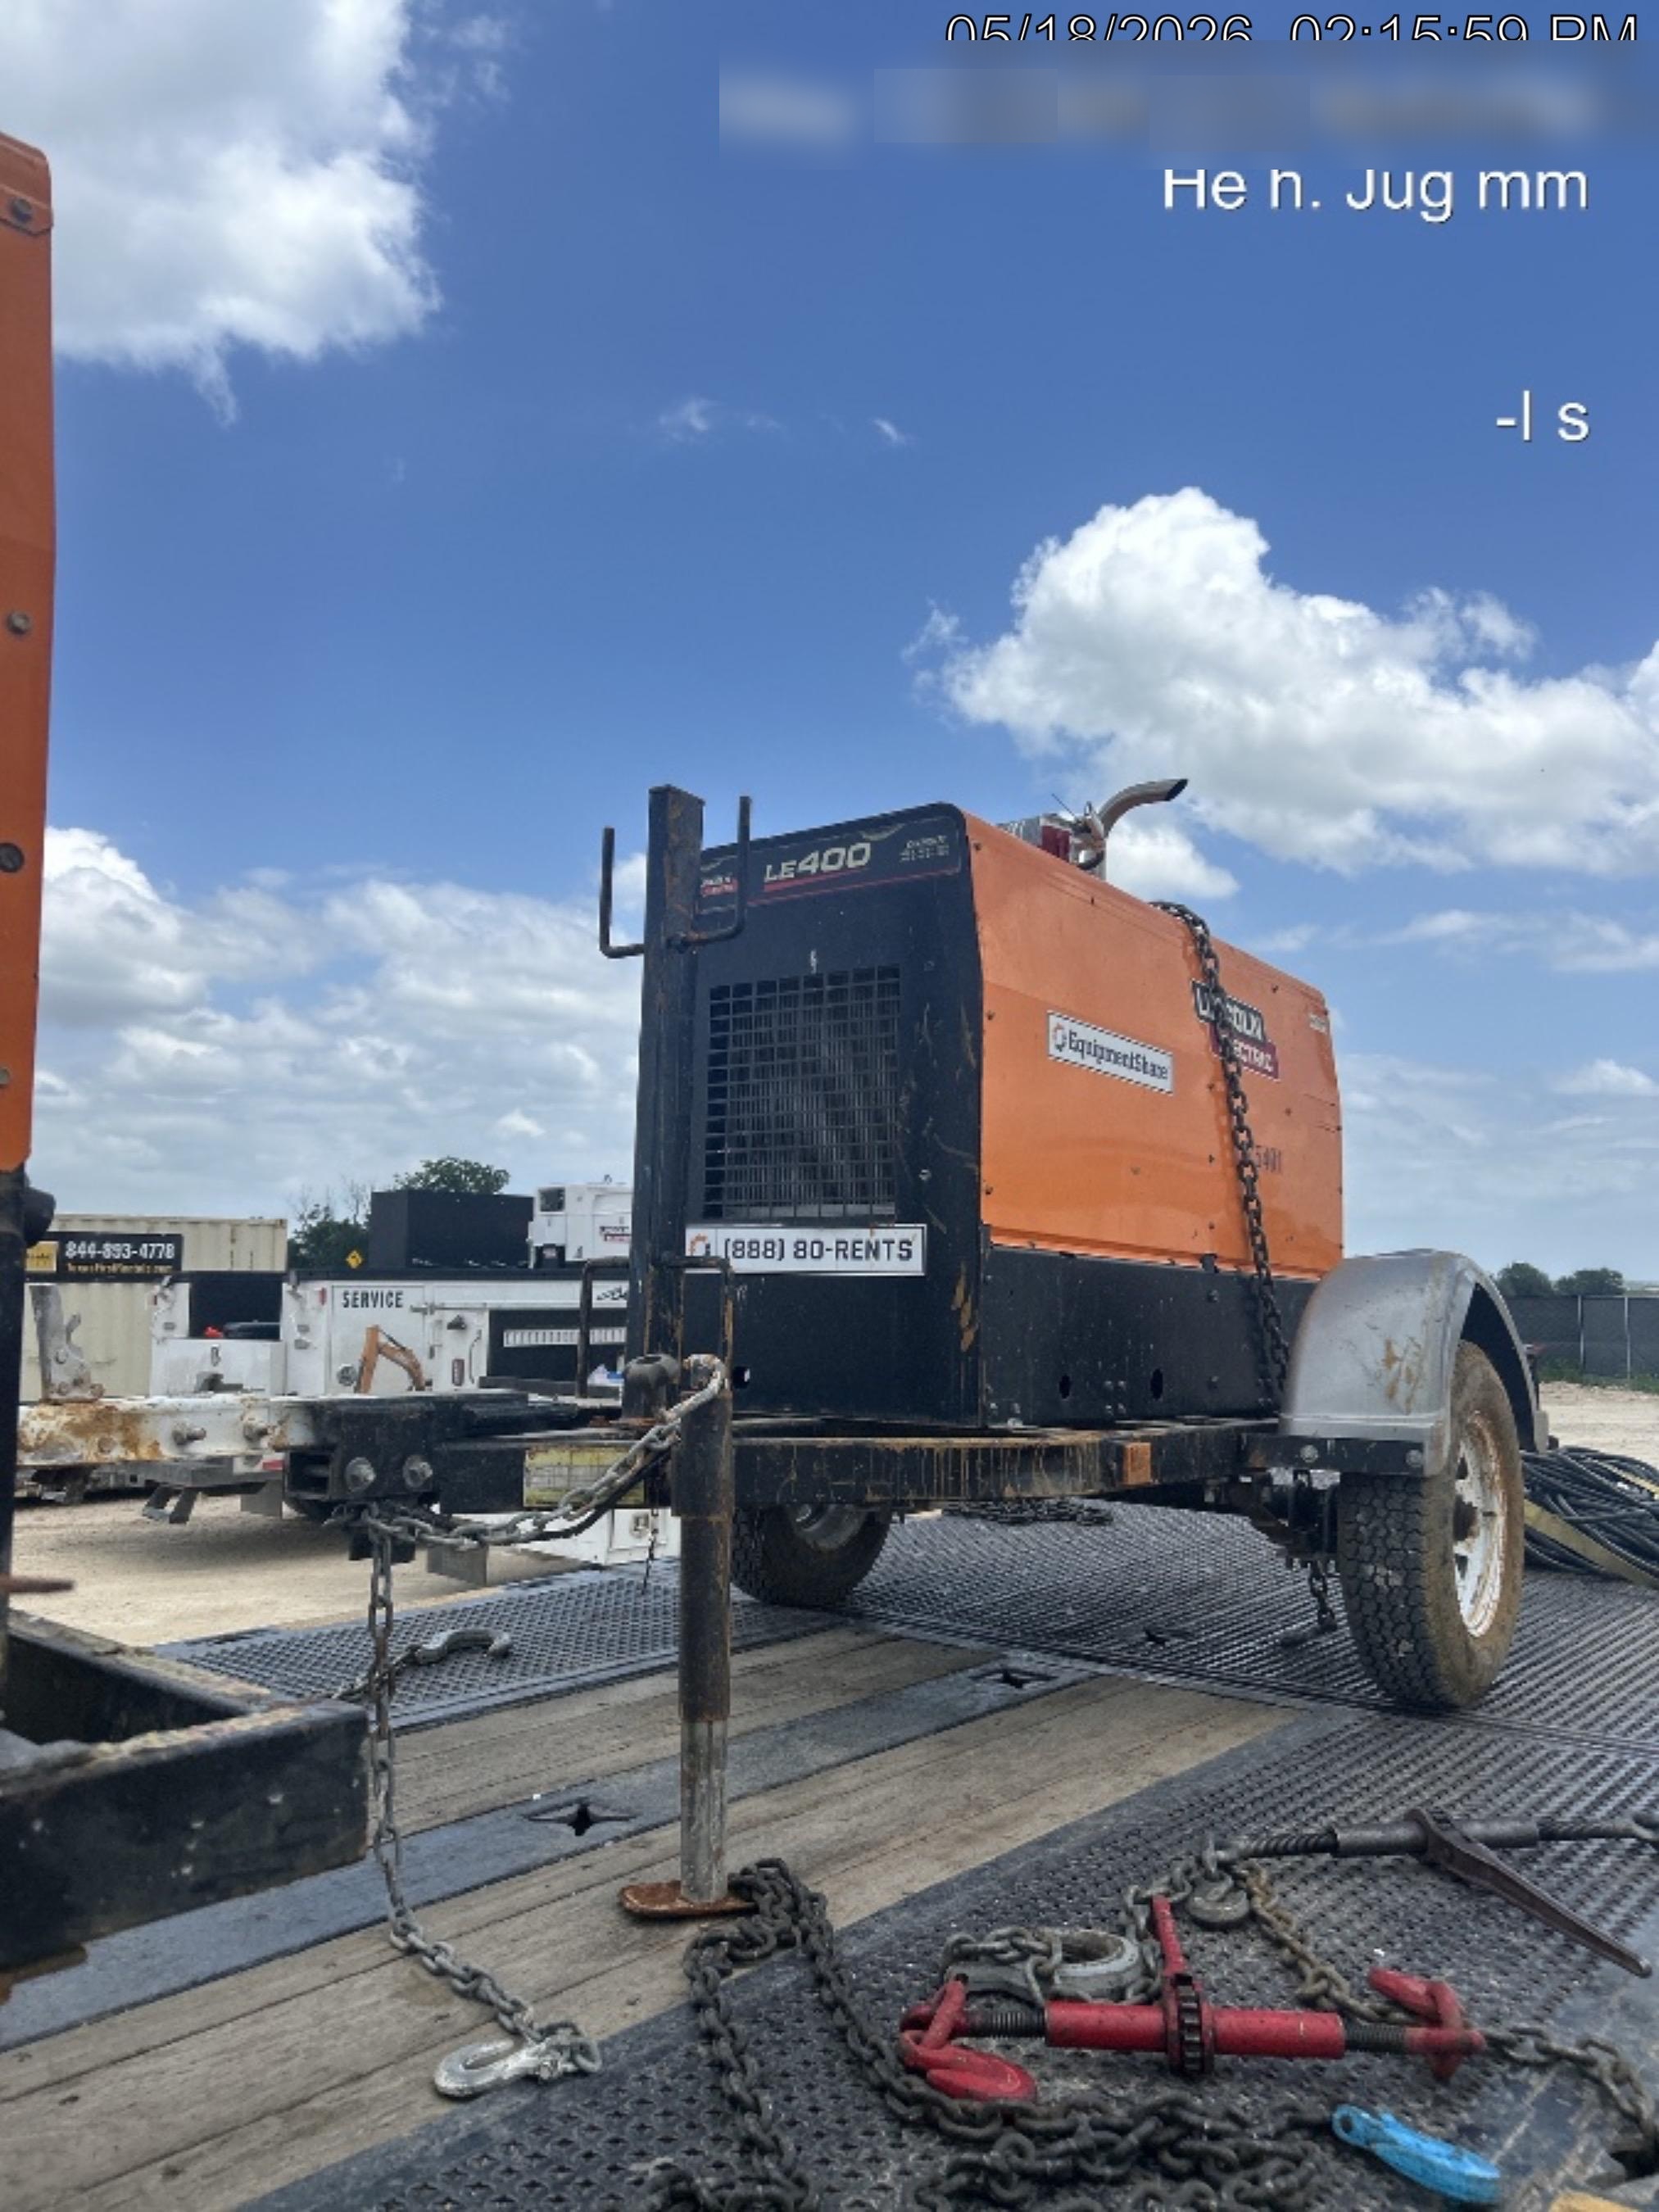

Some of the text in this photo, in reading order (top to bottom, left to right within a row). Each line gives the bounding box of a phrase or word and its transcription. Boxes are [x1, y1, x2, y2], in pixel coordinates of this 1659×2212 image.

[764, 842, 871, 883] LE400
[724, 1238, 913, 1262] (888) 80-RENTS
[342, 1290, 404, 1309] SERVICE
